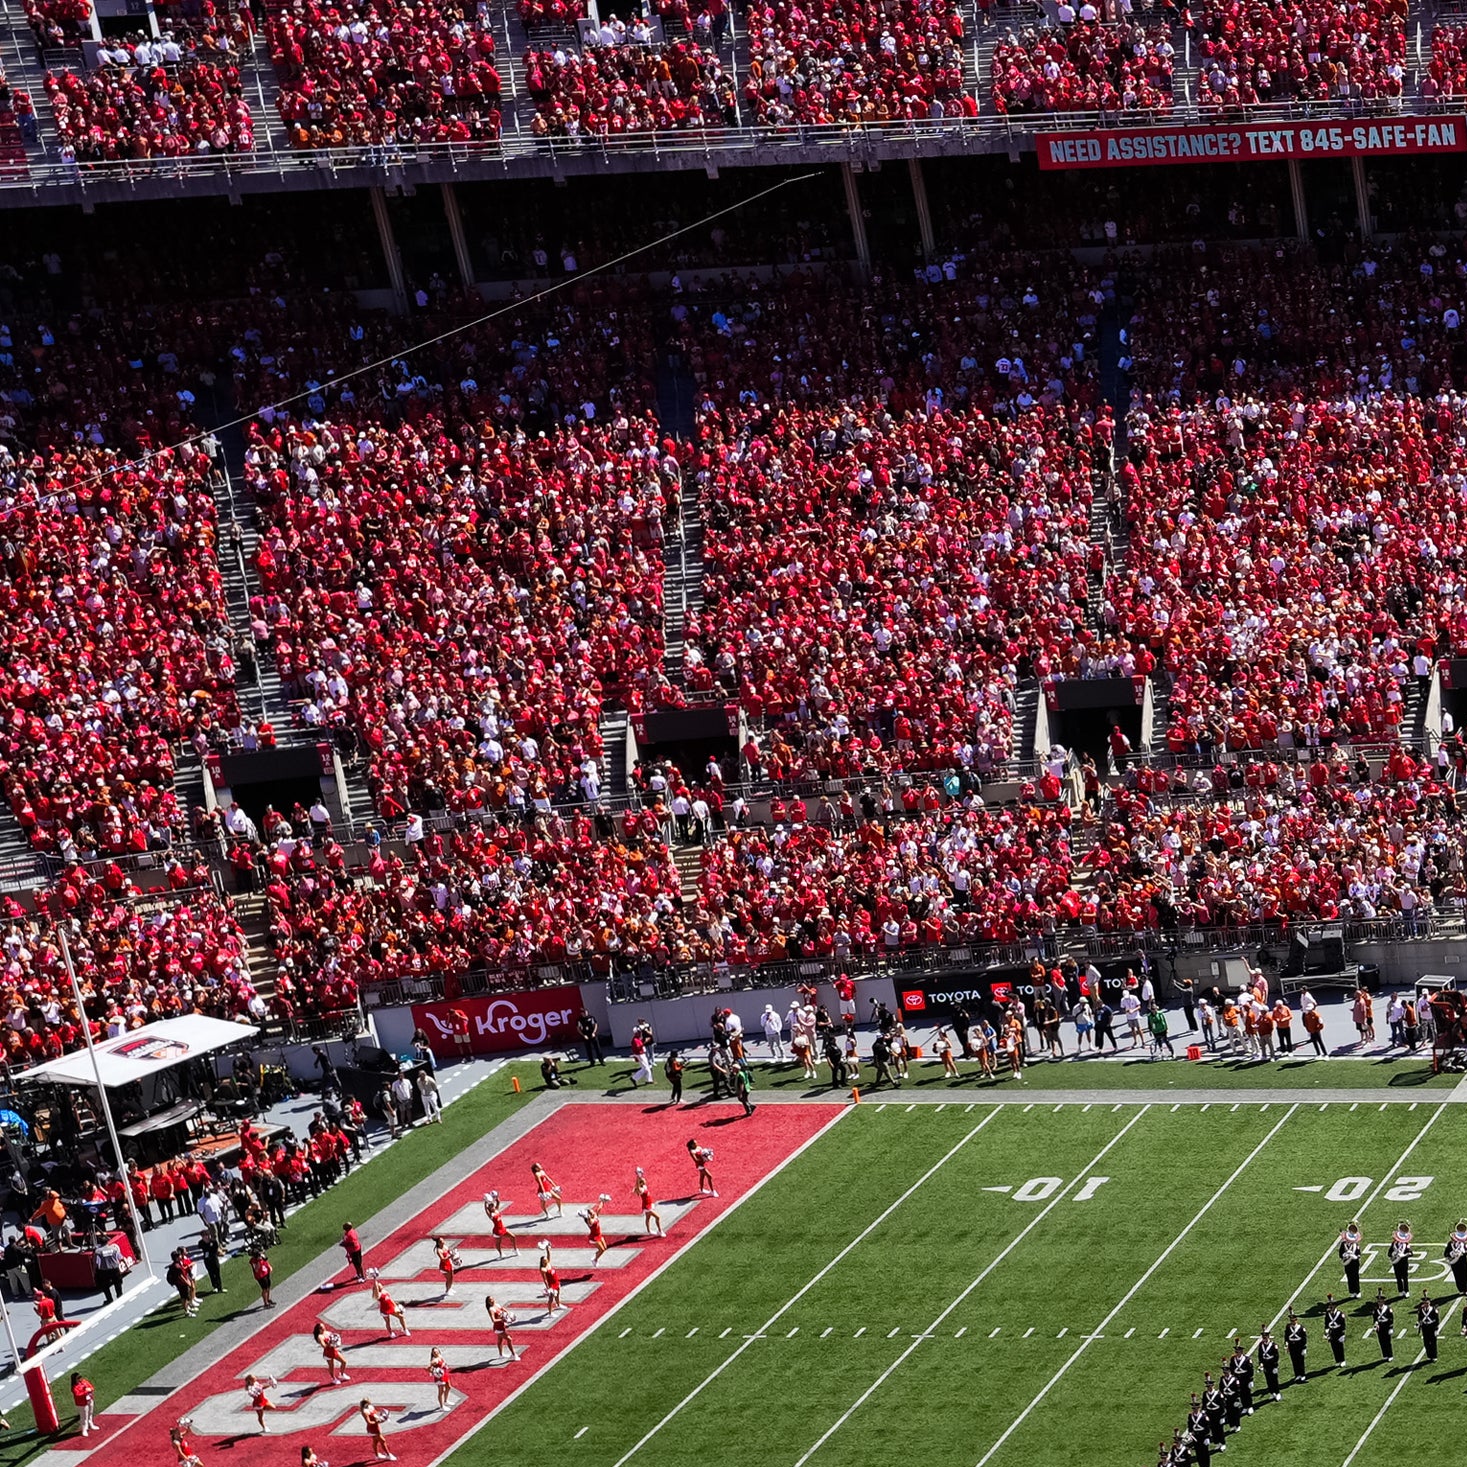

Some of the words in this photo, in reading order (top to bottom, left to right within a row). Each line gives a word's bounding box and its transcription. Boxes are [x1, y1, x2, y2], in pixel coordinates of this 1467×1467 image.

[1050, 138, 1102, 162] NEED
[1107, 132, 1241, 160] ASSISTANCE?
[1246, 129, 1295, 154] TEXT
[1299, 124, 1457, 152] 845-SAFE-FAN
[928, 990, 981, 1004] TOYOTA
[476, 1000, 573, 1045] Kroger
